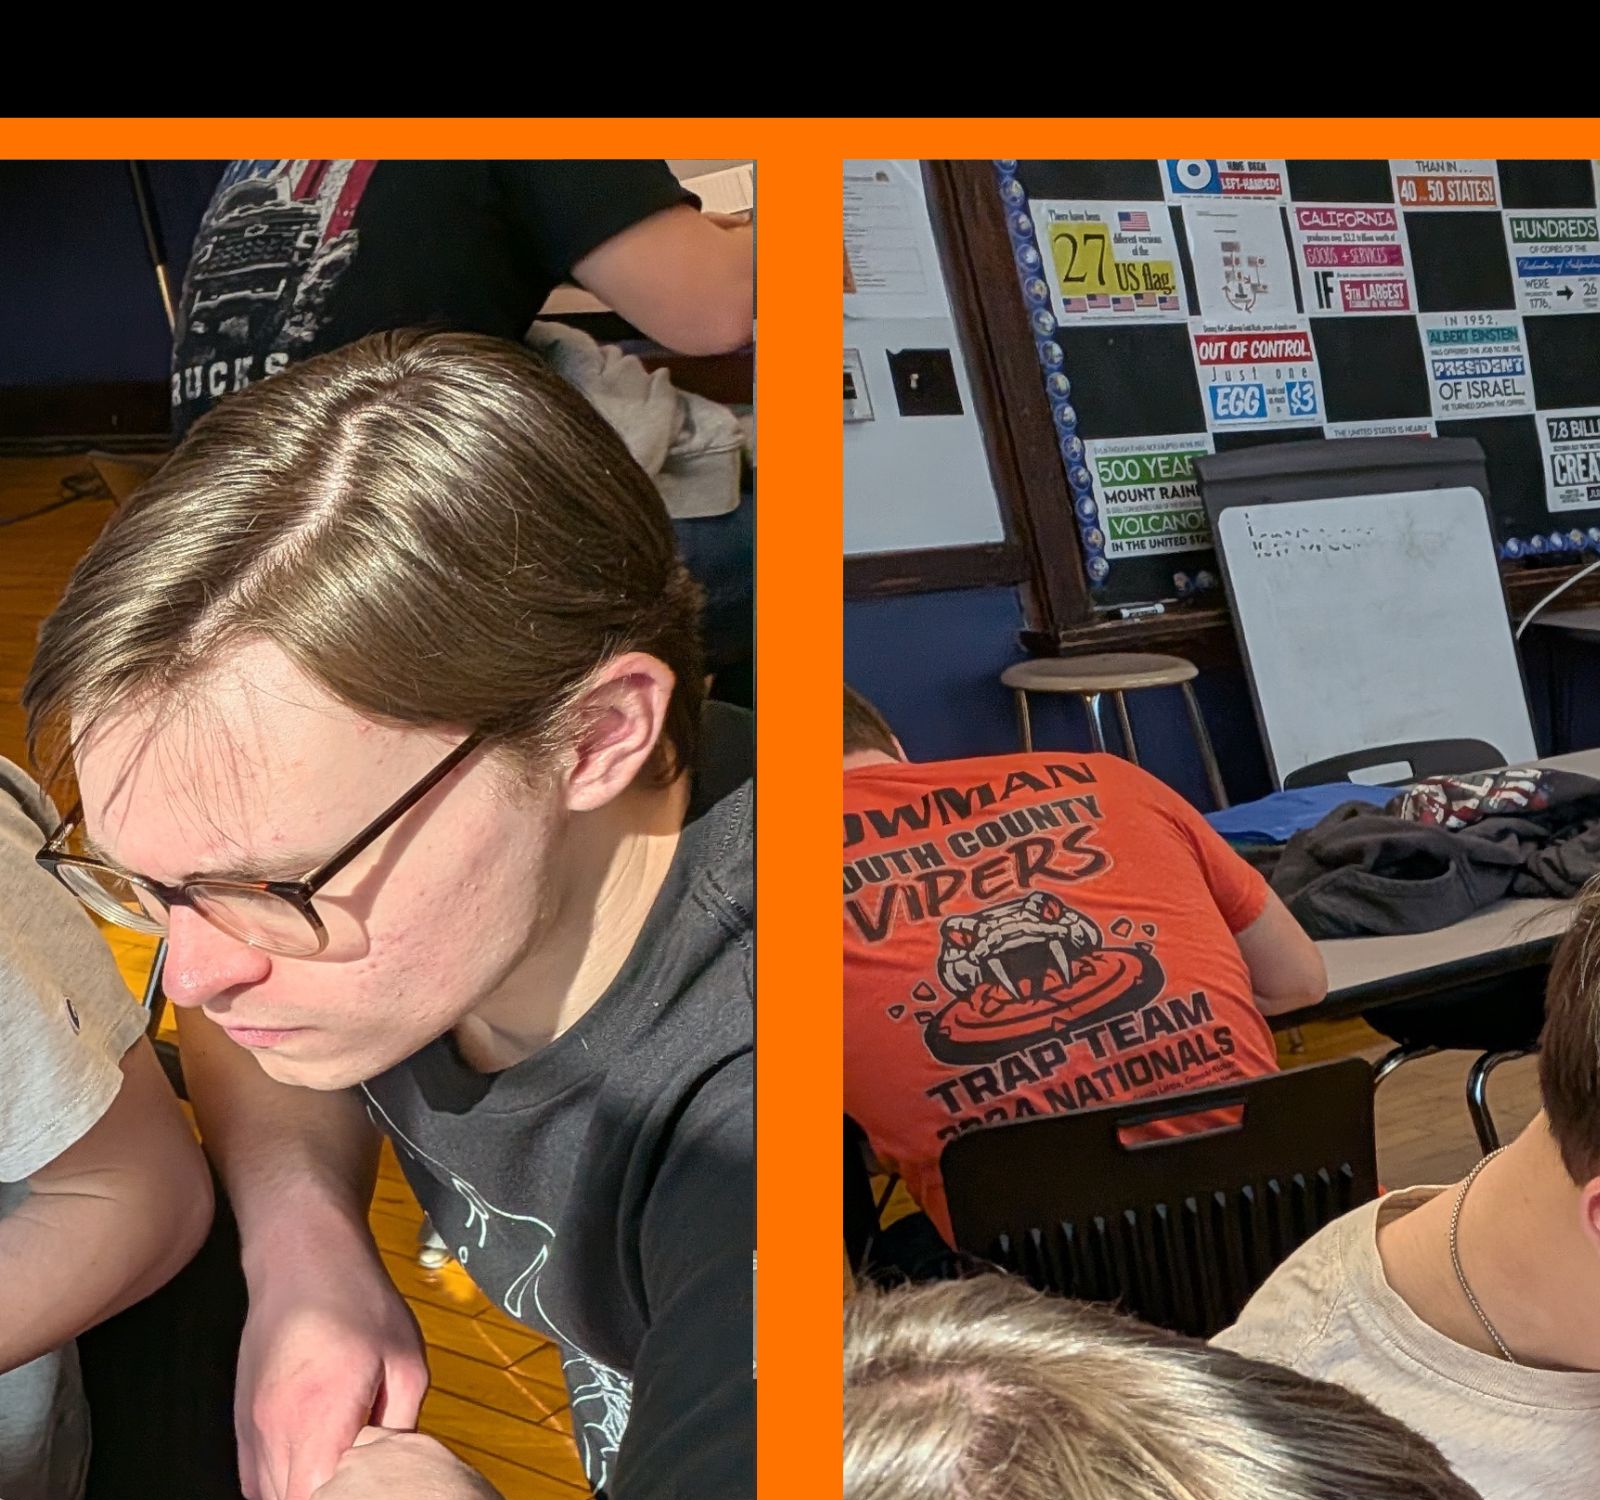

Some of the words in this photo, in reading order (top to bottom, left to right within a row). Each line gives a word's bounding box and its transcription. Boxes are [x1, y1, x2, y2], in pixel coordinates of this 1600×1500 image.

[1446, 180, 1495, 202] STATES!
[1300, 210, 1395, 228] CALIFORNIA
[1512, 219, 1598, 239] HUNDREDS
[1054, 233, 1106, 286] 27
[1115, 263, 1140, 291] US
[1313, 271, 1335, 309] IF
[1583, 282, 1598, 296] 26
[1362, 283, 1404, 300] LARGEST
[1200, 341, 1228, 360] OUT
[1230, 341, 1249, 360] OF
[1250, 338, 1311, 359] CONTROL.
[1216, 386, 1260, 417] EGG
[1290, 381, 1314, 414] $3
[1438, 381, 1462, 401] OF
[1097, 458, 1141, 483] 500
[1142, 456, 1197, 479] YEAR
[1103, 487, 1156, 505] MOUNT
[1126, 541, 1147, 551] THE
[1149, 536, 1187, 549] UNITED
[947, 793, 1104, 861] COUNTY
[845, 823, 1110, 944] VIPERS
[925, 1039, 1070, 1115] TRAP
[1070, 991, 1216, 1059] TEAM
[1048, 1025, 1237, 1116] NATIONALS
